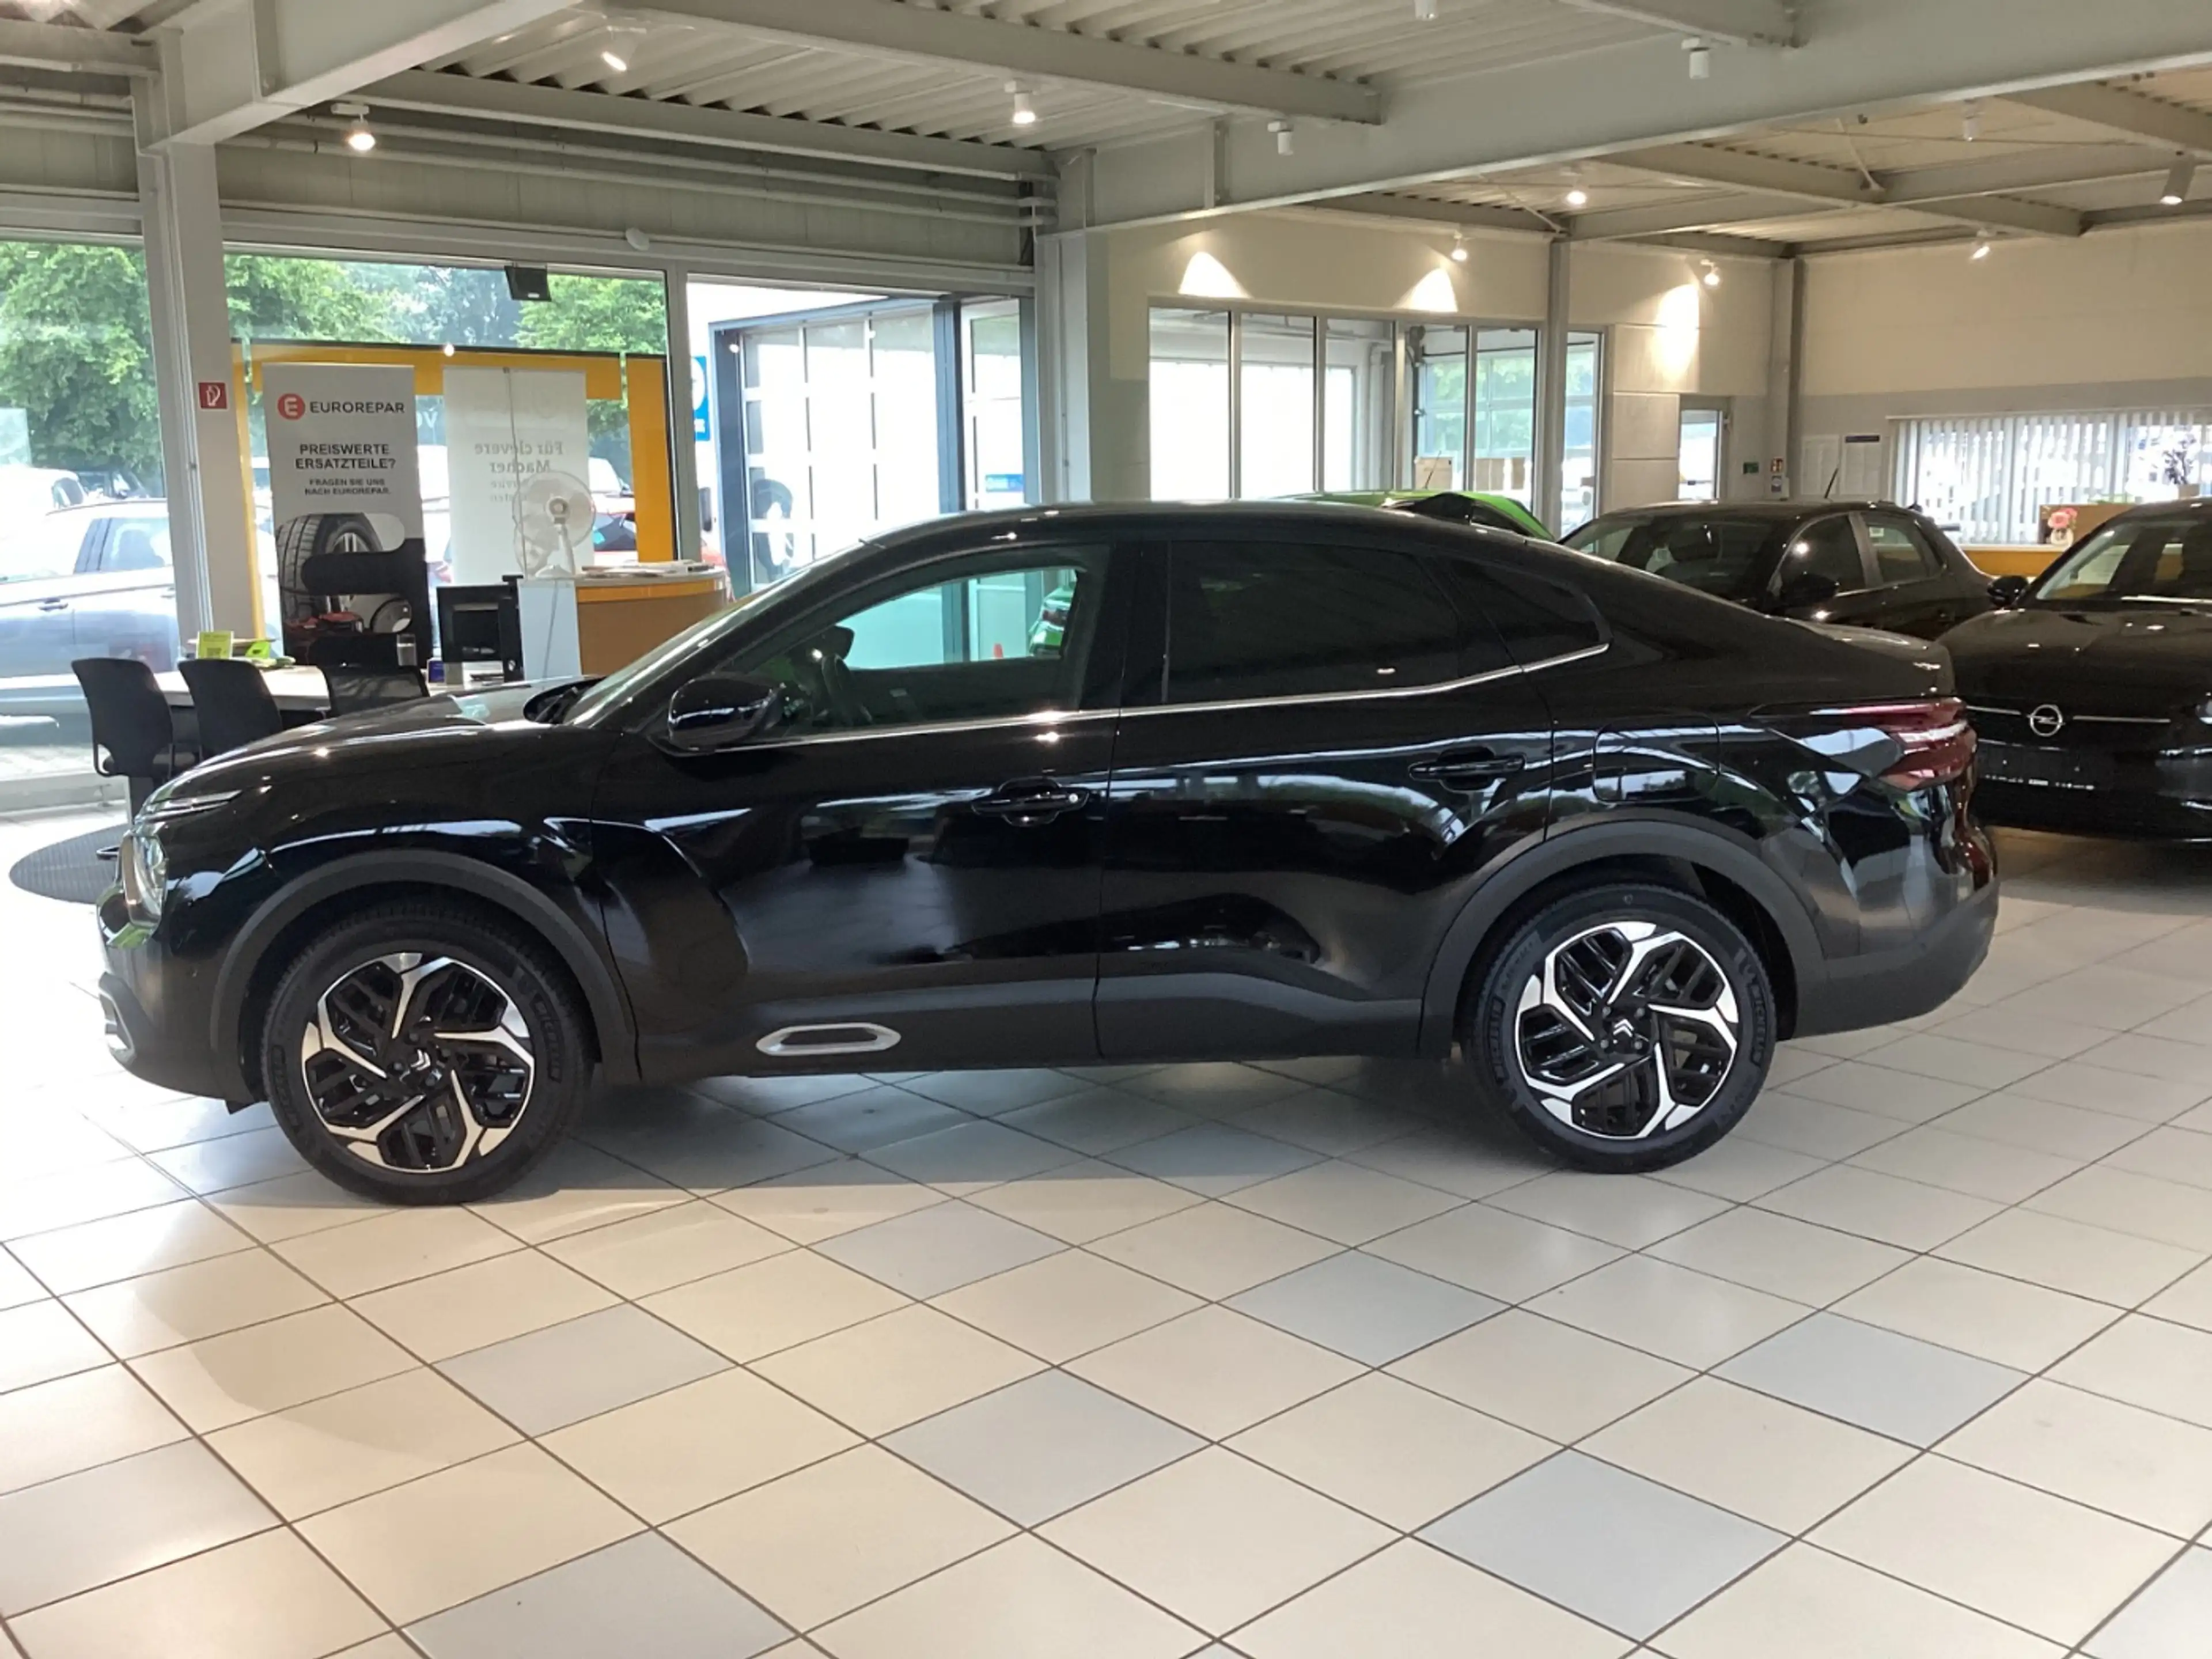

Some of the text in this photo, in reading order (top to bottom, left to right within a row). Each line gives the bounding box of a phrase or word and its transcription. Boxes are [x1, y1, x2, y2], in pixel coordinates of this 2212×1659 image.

[309, 402, 405, 413] EUROREPAR
[300, 444, 390, 455] PREISWERTE
[295, 459, 396, 470] ERSATZTEILE?
